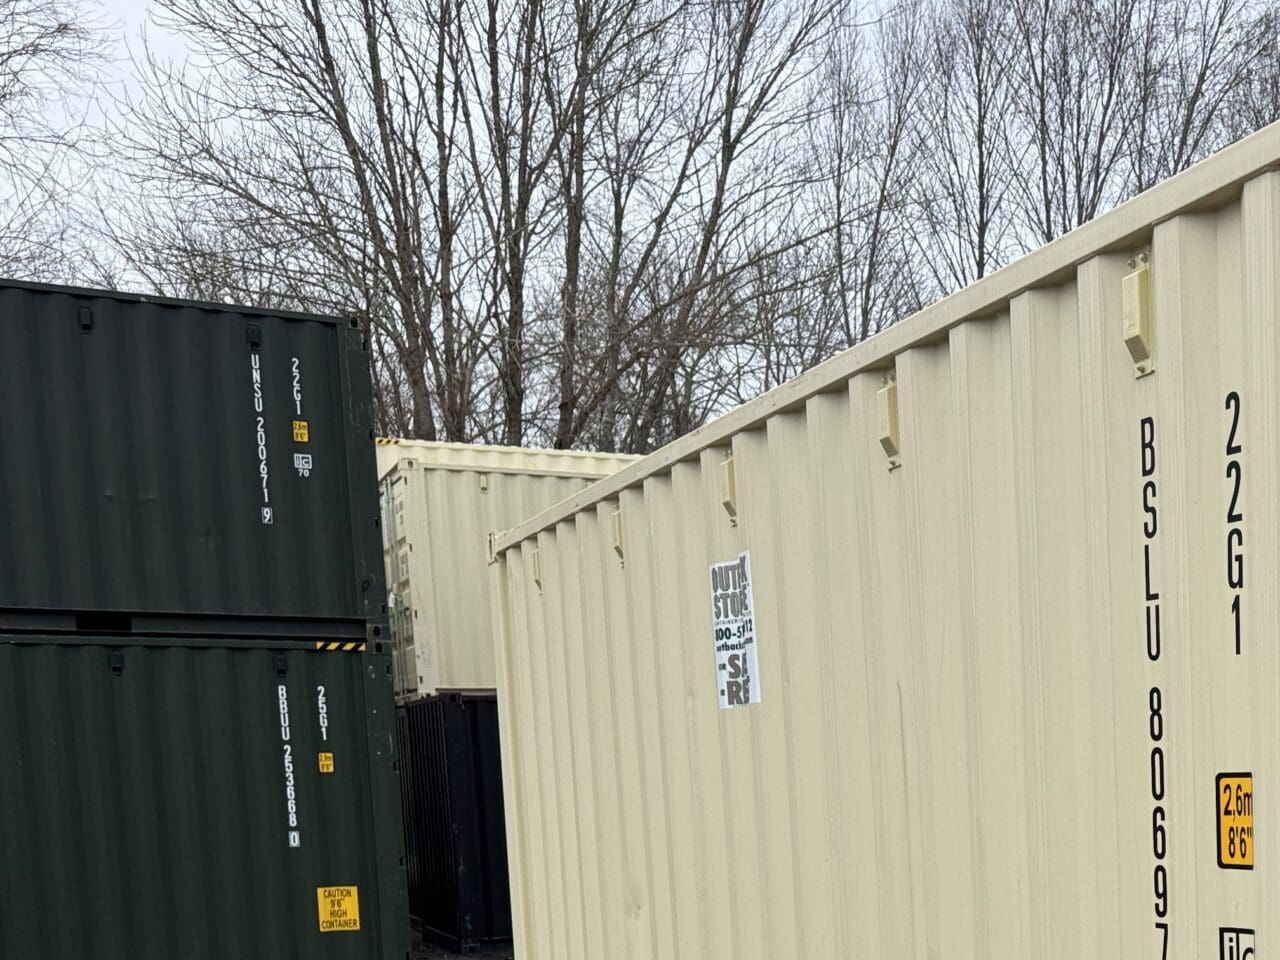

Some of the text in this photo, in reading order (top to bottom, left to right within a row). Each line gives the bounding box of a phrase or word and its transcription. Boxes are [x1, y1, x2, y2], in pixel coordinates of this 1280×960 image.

[291, 357, 301, 415] 22G1
[251, 354, 272, 523] UNSU 200671 9
[1140, 416, 1160, 661] BSLU
[1225, 391, 1243, 655] 22G1
[278, 685, 290, 741] BBUU
[317, 685, 327, 741] 25G1
[283, 744, 297, 827] 253668
[323, 888, 351, 898] CAUTION
[330, 909, 347, 918] HIGH
[321, 919, 358, 929] CONTAINER
